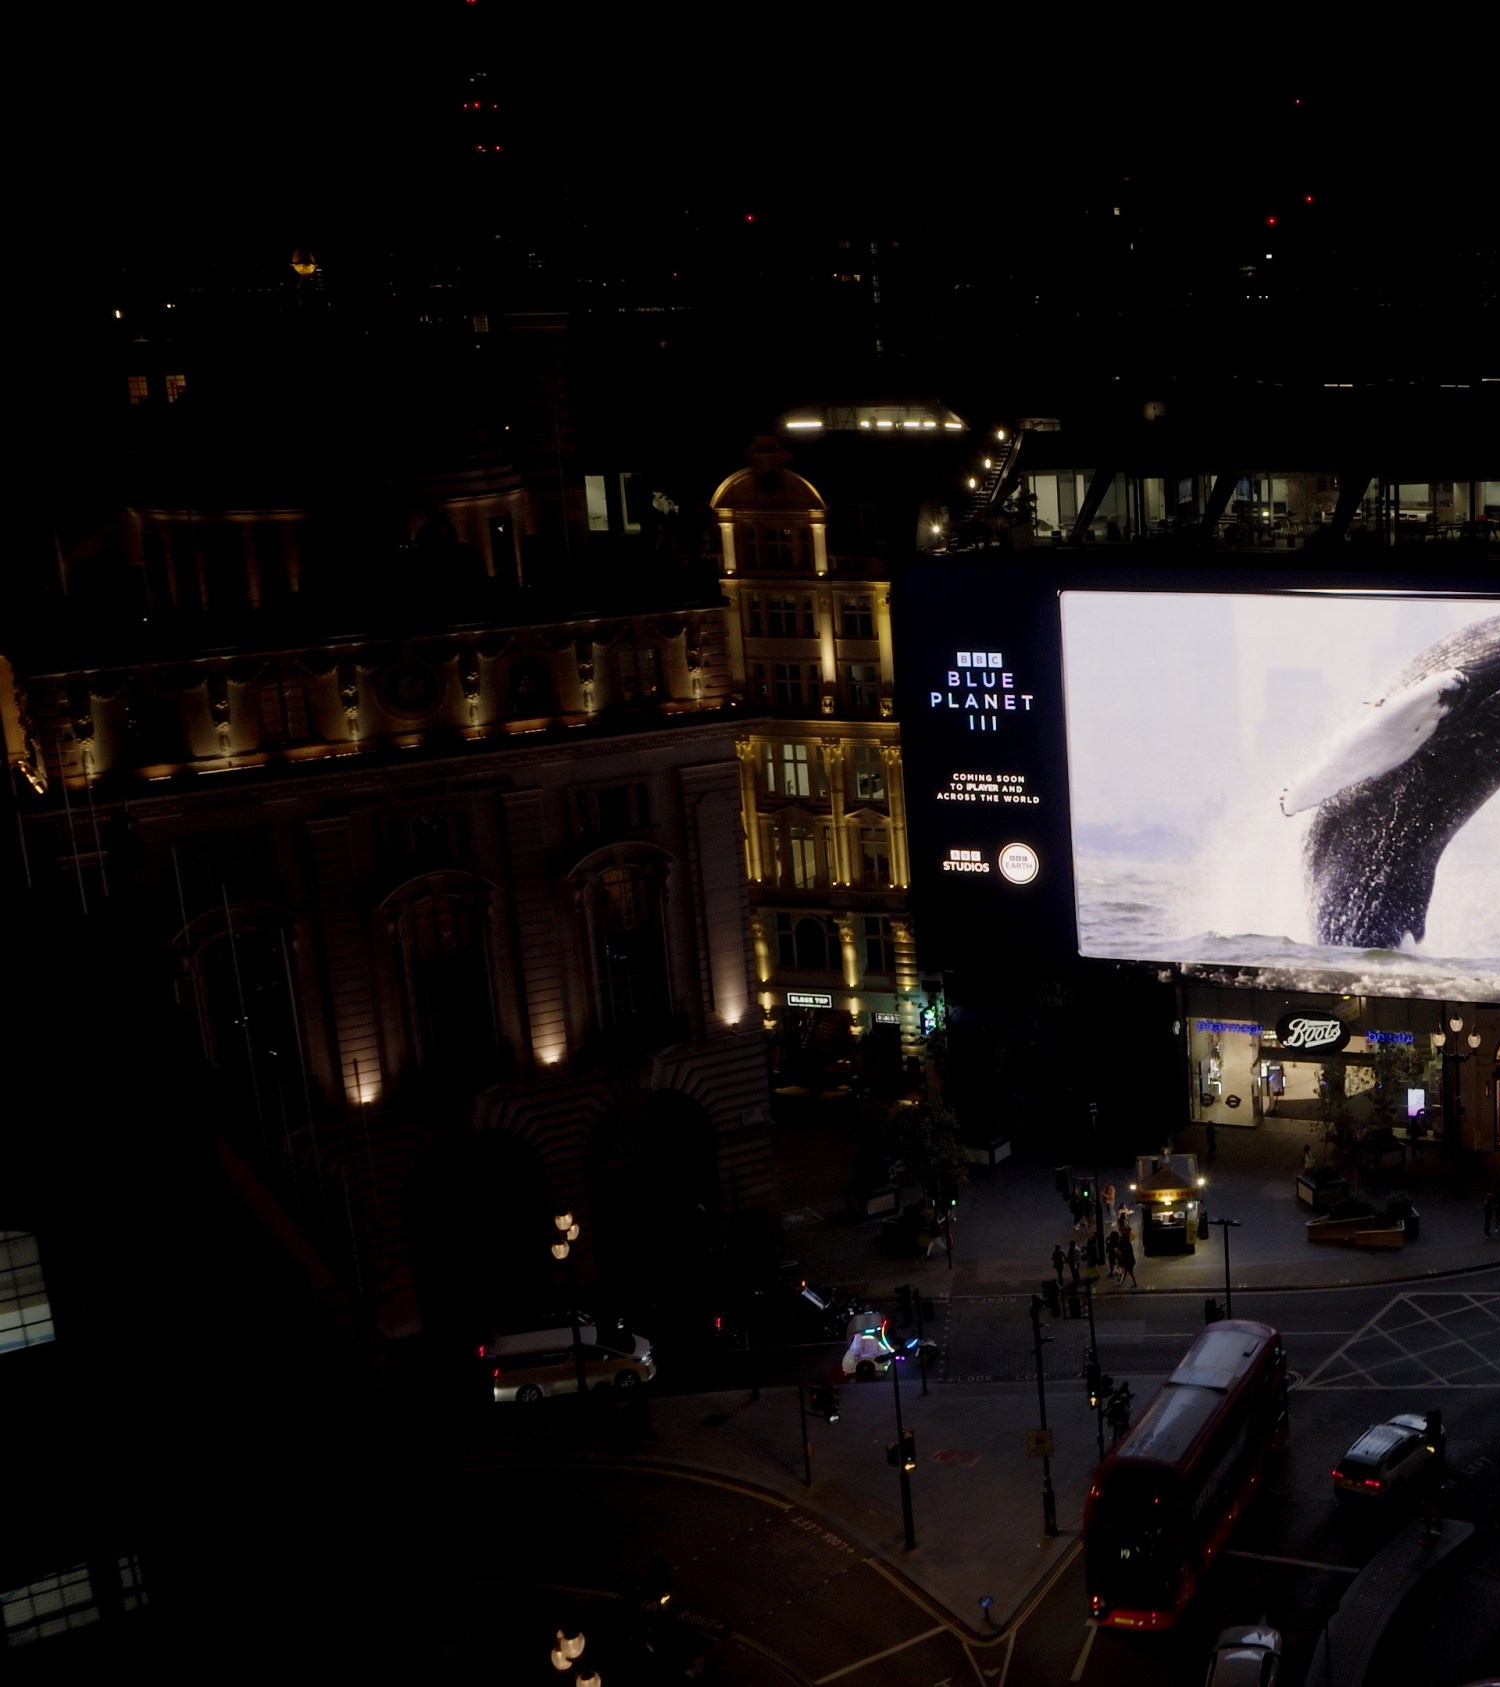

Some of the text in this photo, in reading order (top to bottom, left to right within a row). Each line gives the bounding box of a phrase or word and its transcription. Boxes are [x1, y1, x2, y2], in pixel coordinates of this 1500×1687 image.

[958, 653, 1001, 667] BBC
[948, 671, 1014, 688] BLUE
[930, 692, 1034, 710] PLANET
[969, 715, 997, 731] III
[953, 773, 1025, 783] COMING SOON
[950, 783, 963, 791] TO
[1002, 785, 1023, 793] AND
[937, 793, 1040, 804] ACROSS THE WORLD
[951, 850, 981, 862] BBC
[943, 861, 990, 873] STUDIOS
[1005, 862, 1033, 870] EARTH
[1197, 1020, 1264, 1036] pharmacy
[1283, 1018, 1341, 1048] Boots
